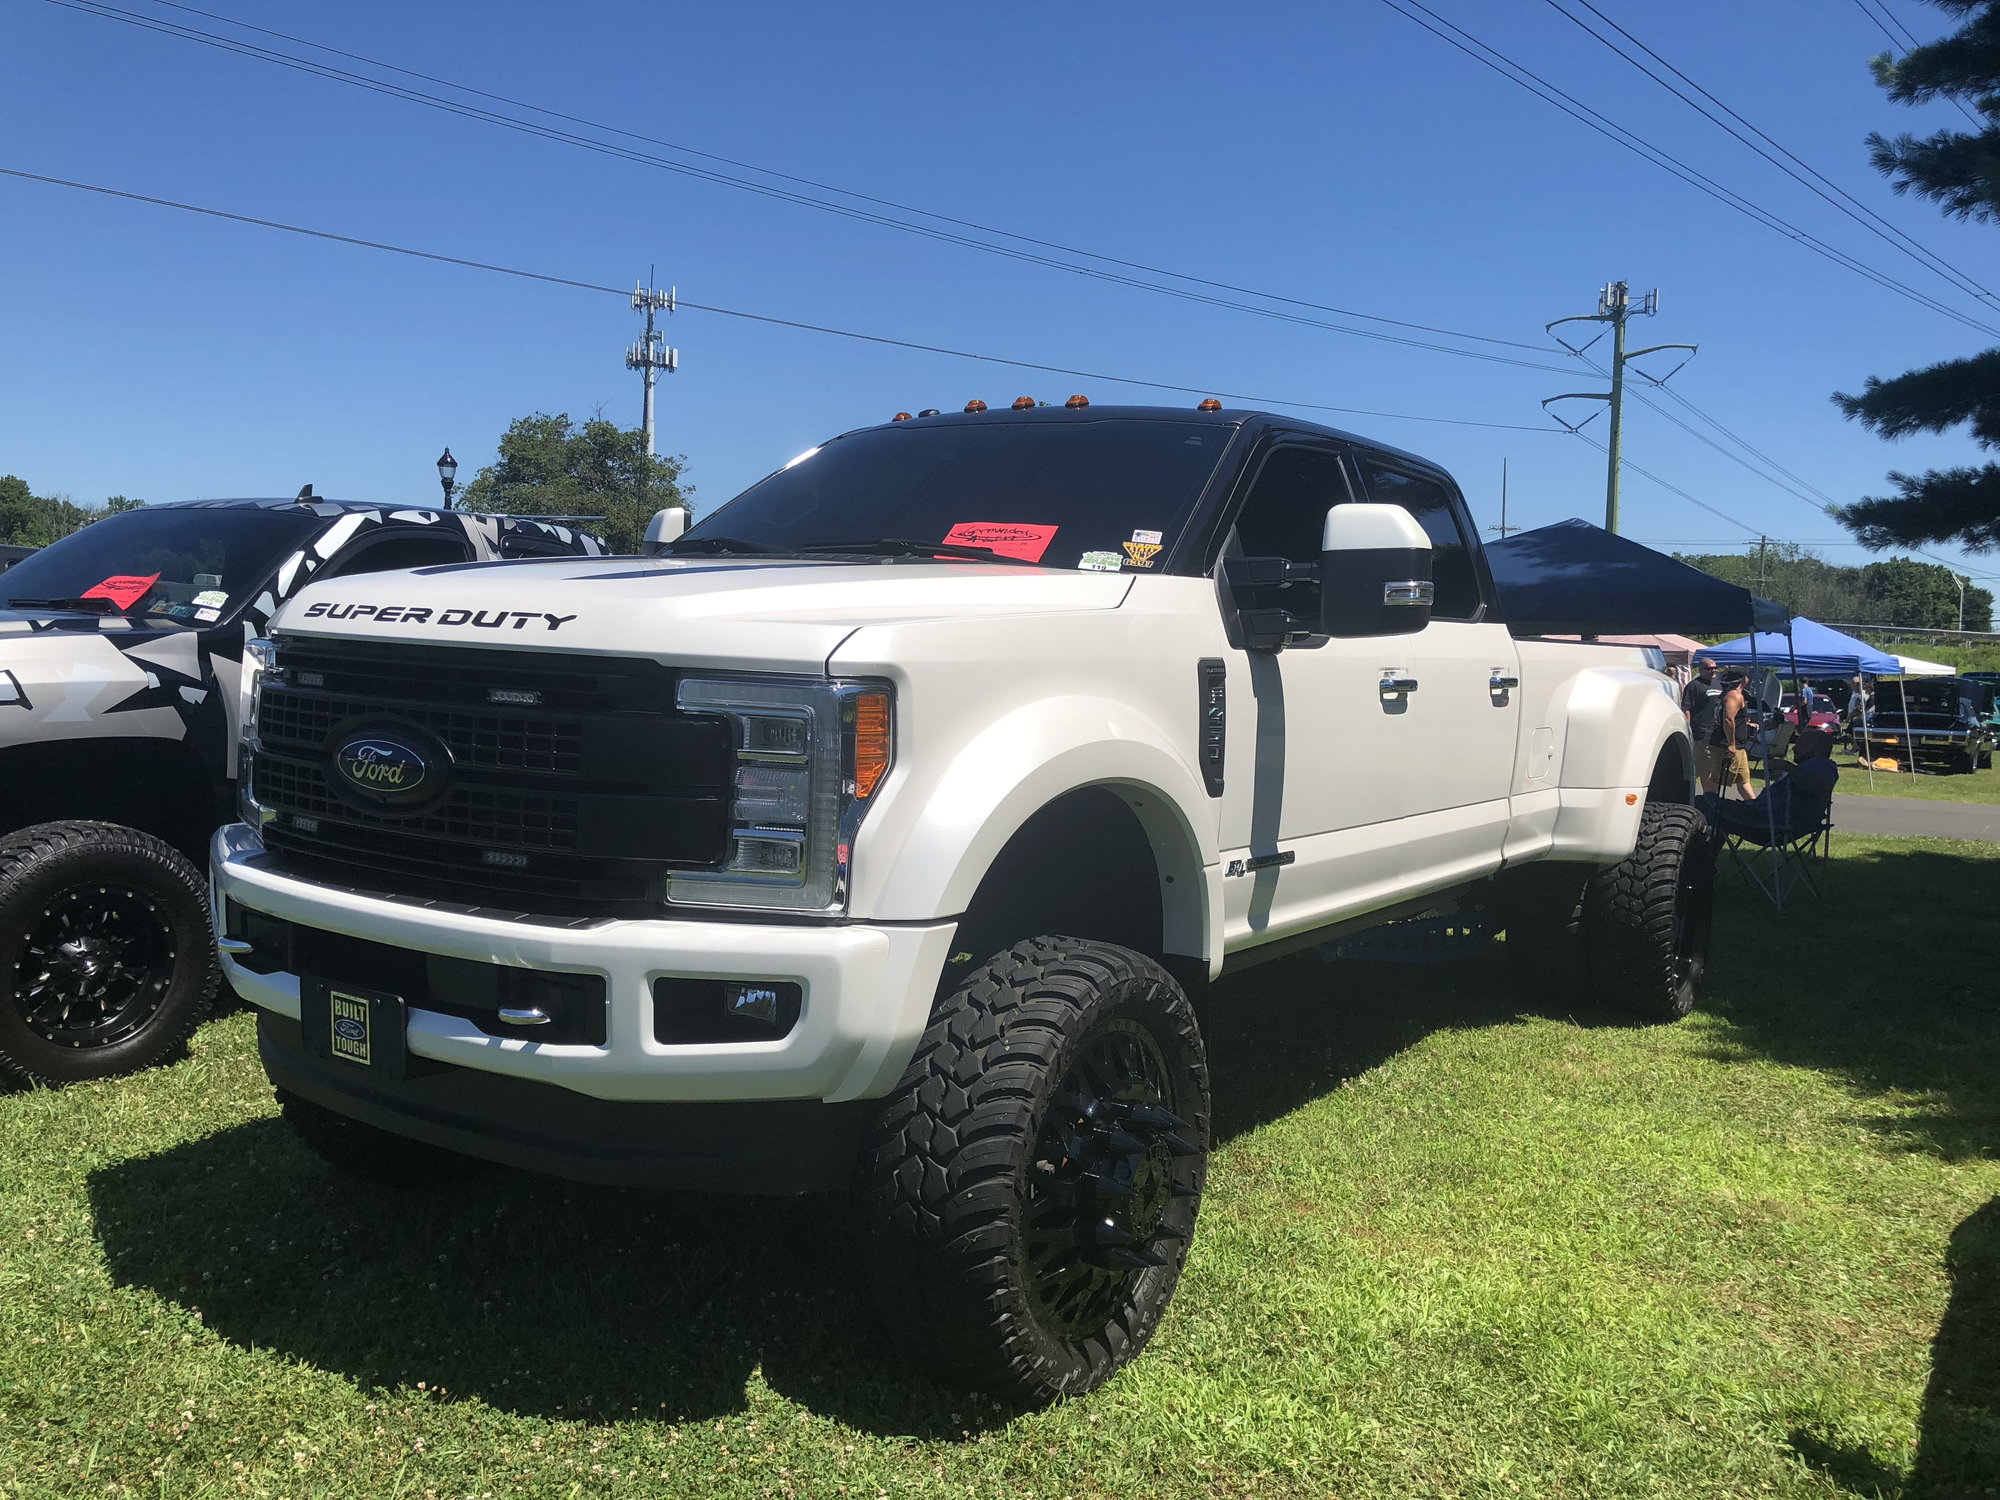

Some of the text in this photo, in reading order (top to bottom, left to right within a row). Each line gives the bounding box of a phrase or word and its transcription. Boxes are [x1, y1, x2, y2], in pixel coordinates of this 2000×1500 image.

[303, 602, 578, 631] SUPER DUTY
[349, 745, 404, 784] Ford
[335, 999, 365, 1022] BUILT
[340, 1022, 359, 1036] Ford
[335, 1035, 366, 1058] TOUGH
